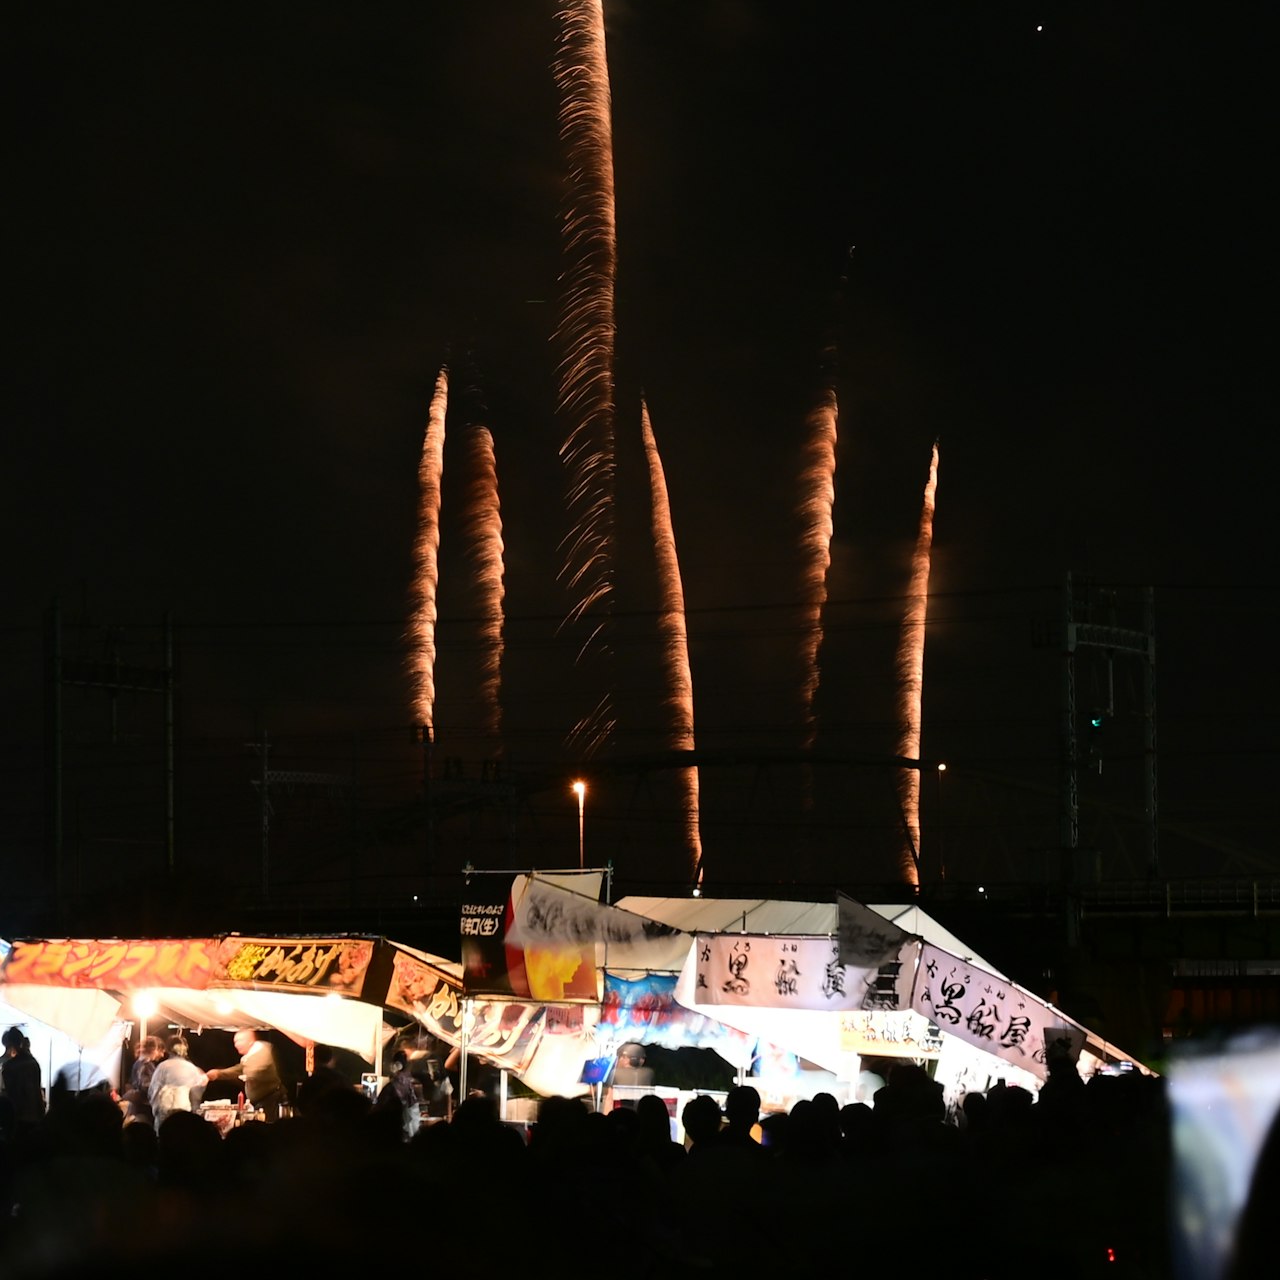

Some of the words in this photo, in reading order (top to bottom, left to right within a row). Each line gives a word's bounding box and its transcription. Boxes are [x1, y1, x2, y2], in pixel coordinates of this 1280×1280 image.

[5, 941, 211, 980] フランクフルト
[722, 952, 848, 1000] 黒船屋
[933, 976, 1033, 1057] 黒船屋
